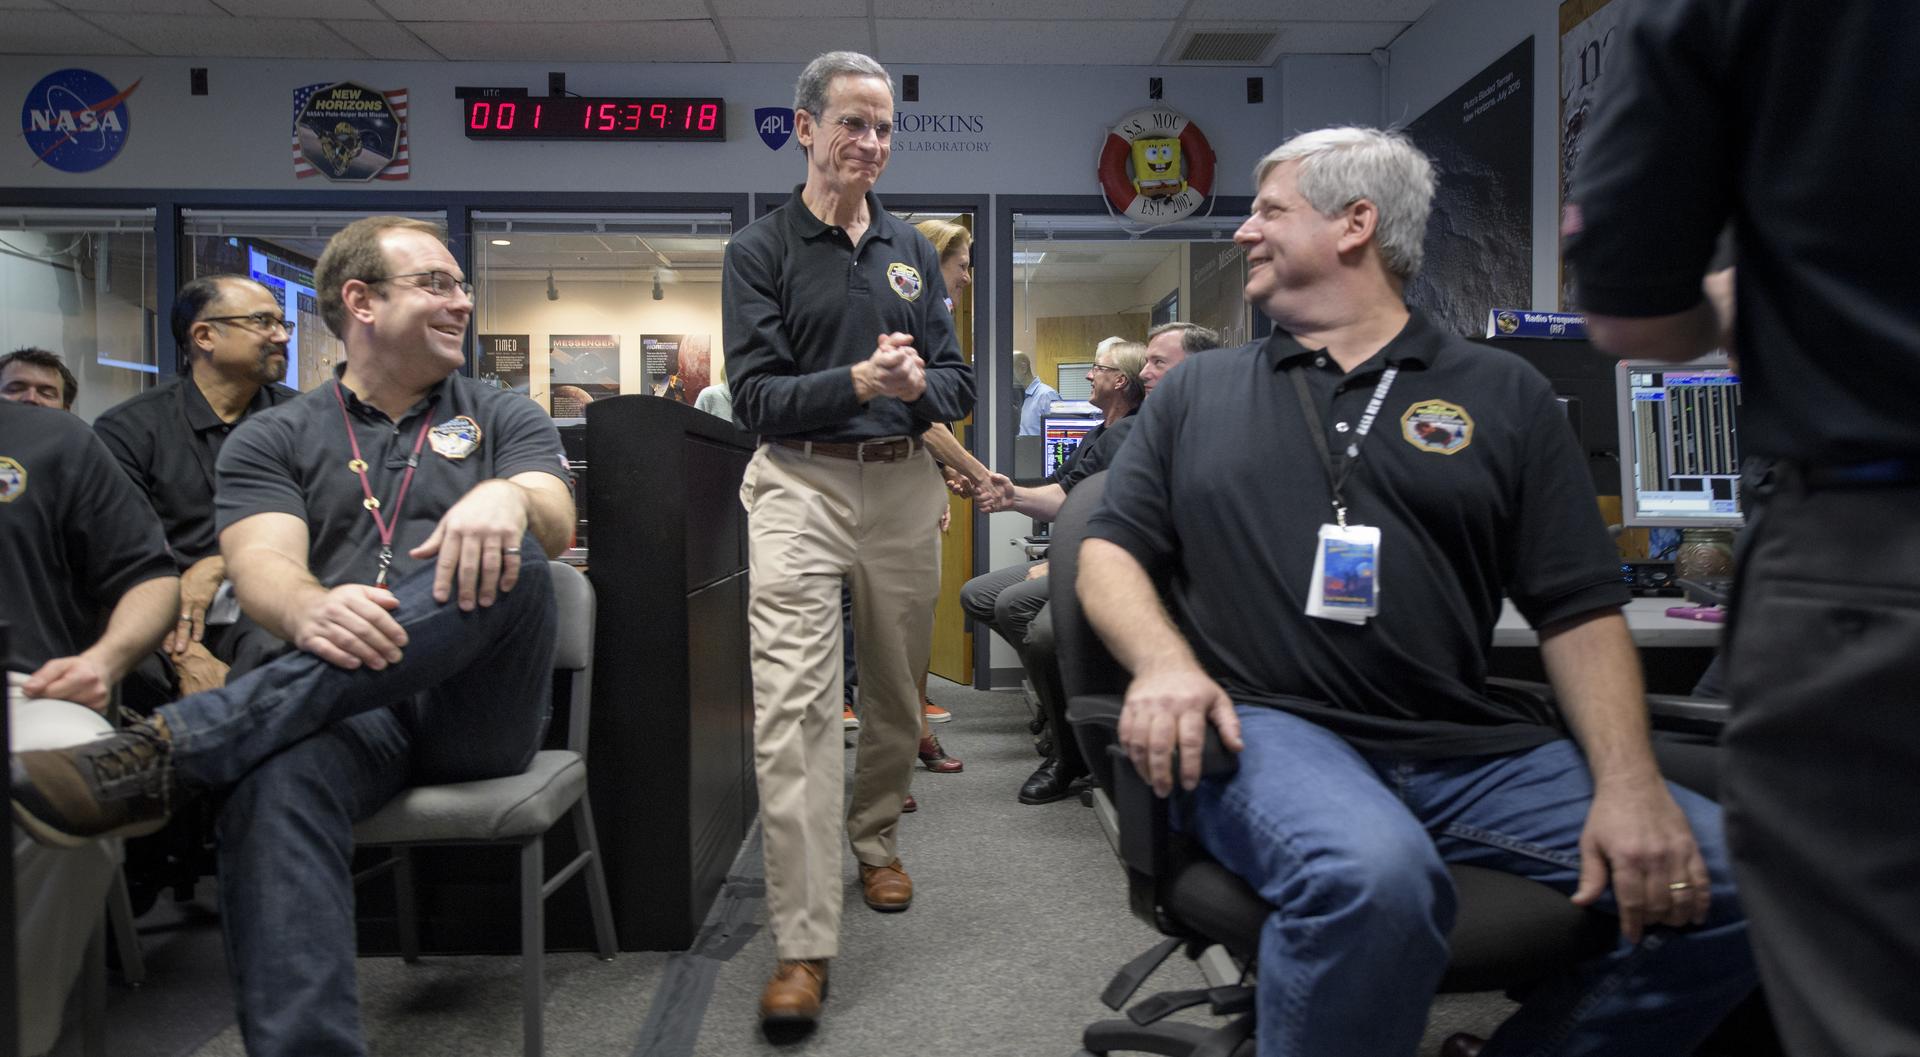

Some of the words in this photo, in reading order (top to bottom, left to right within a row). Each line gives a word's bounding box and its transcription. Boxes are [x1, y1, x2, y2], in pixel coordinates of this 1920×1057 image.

[331, 89, 362, 100] NEW
[315, 100, 383, 111] HORIZONS
[30, 109, 122, 132] NASA
[471, 102, 541, 129] 001
[583, 104, 718, 131] 15:39:18
[759, 115, 791, 134] APL
[1124, 119, 1146, 140] S.S.
[1152, 112, 1181, 130] MOC
[908, 141, 992, 152] LABORATORY
[1141, 199, 1165, 217] EST.
[1172, 193, 1193, 214] 2002
[1524, 313, 1547, 323] Radio
[1549, 323, 1566, 335] (RF)
[495, 338, 517, 352] TIMED
[553, 339, 616, 347] MESSENGER
[1355, 414, 1376, 436] NASA
